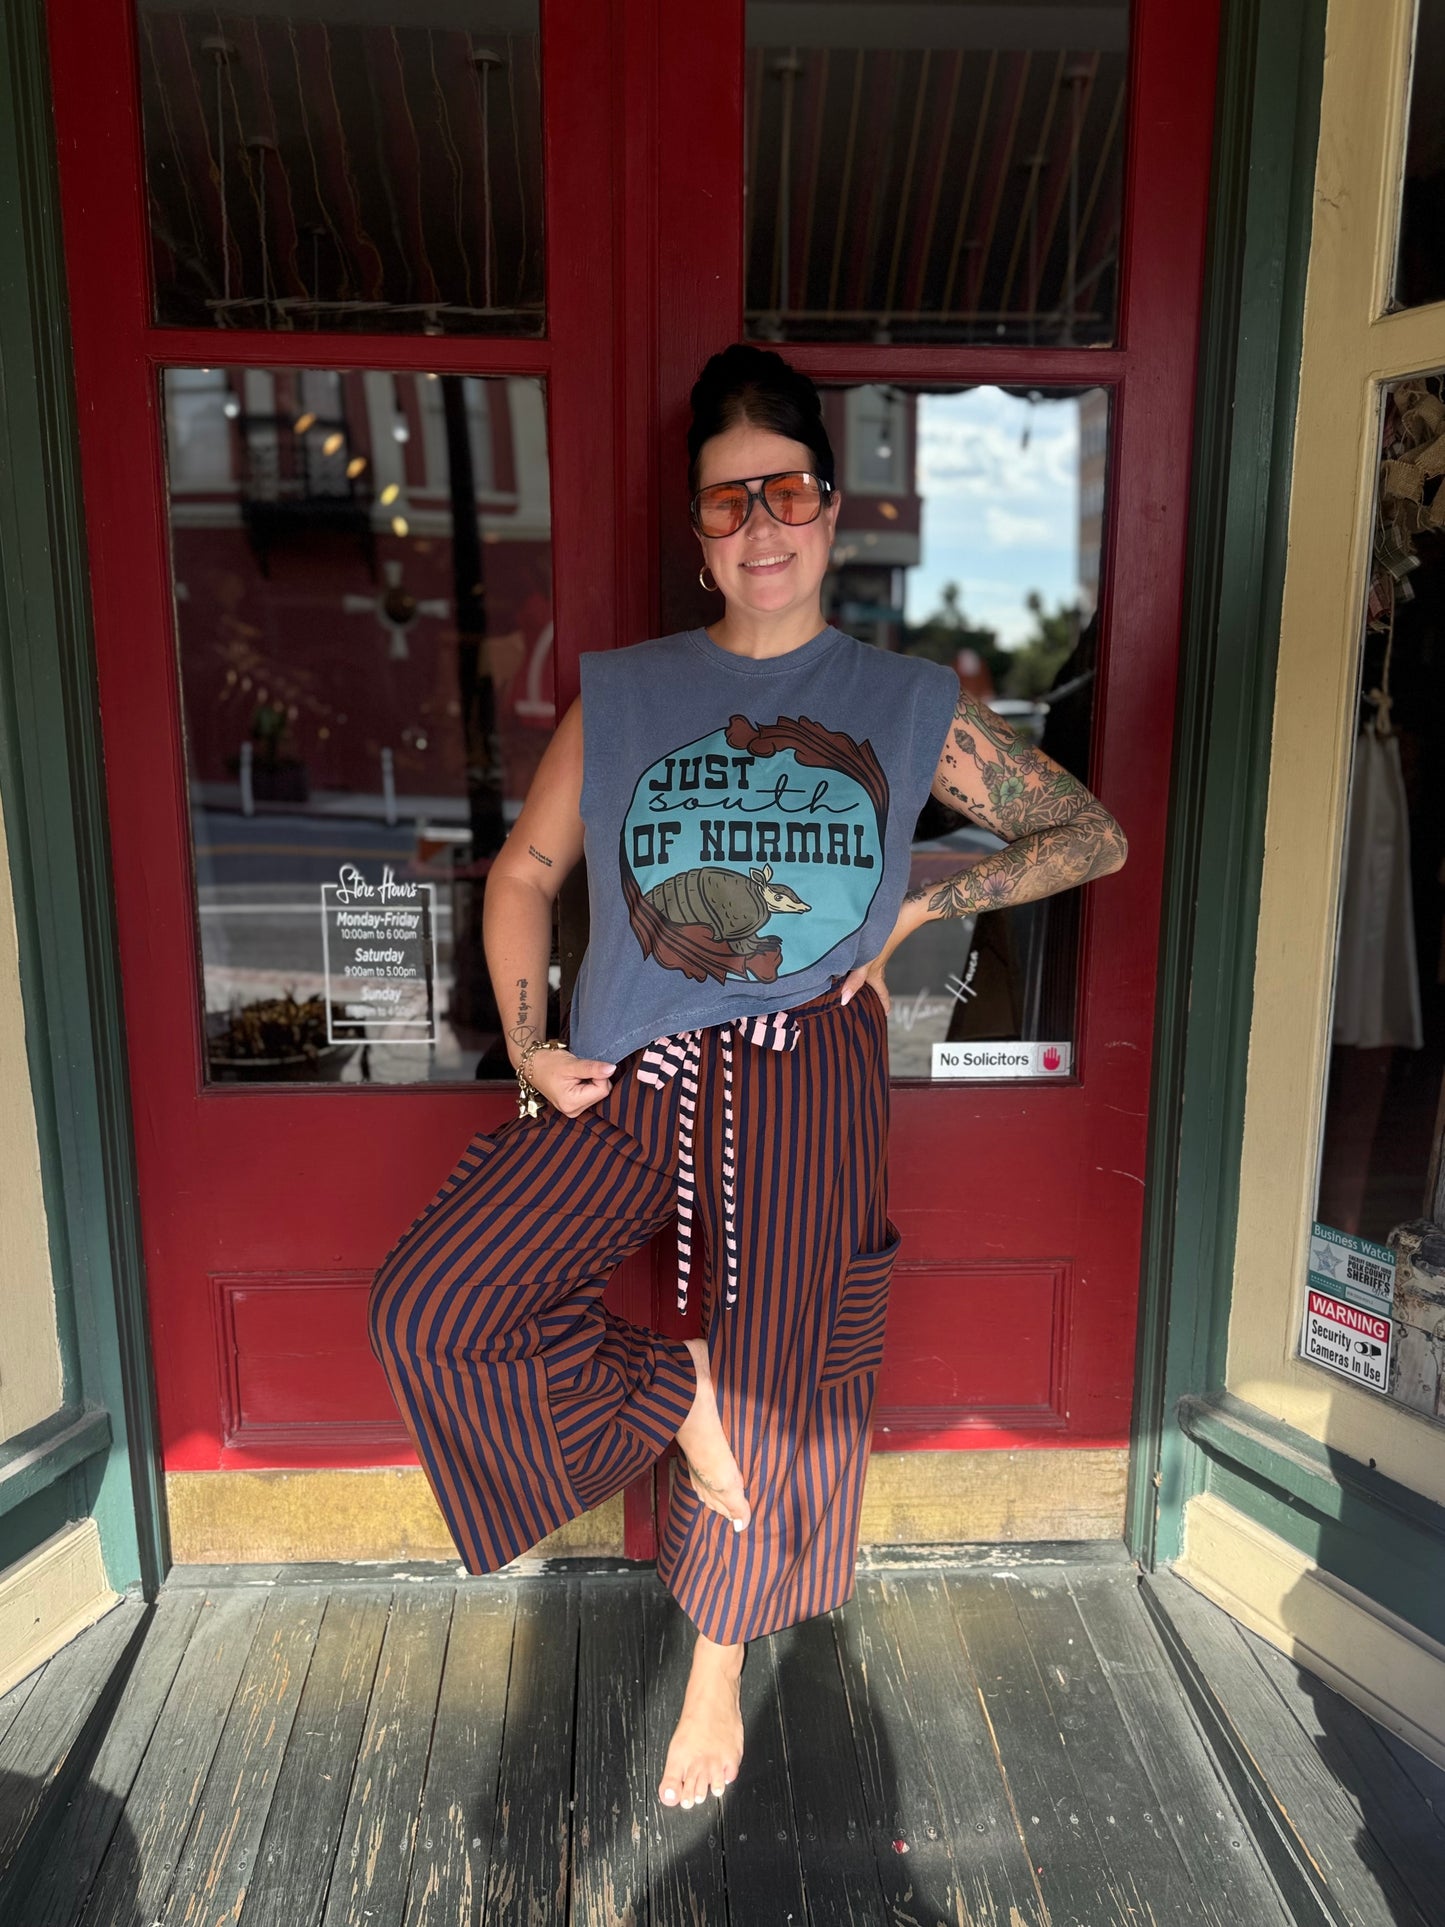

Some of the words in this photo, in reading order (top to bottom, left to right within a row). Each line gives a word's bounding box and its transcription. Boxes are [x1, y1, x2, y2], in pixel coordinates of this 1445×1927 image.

[649, 754, 755, 791] JUST
[649, 774, 859, 814] south
[633, 821, 681, 868] OF
[700, 820, 874, 869] NORMAL
[336, 863, 374, 904] Store
[378, 865, 417, 904] Hours
[336, 911, 420, 929] Monday-Friday
[341, 928, 374, 939] 10:00am
[376, 930, 385, 939] to
[344, 966, 374, 977] 9:00am
[376, 967, 385, 977] to
[355, 947, 404, 964] Saturday
[361, 985, 401, 1003] Sunday
[940, 1053, 959, 1066] No
[963, 1052, 1029, 1066] Solicitors
[1314, 1224, 1358, 1250] Business
[1361, 1241, 1394, 1263] Watch
[1347, 1260, 1364, 1272] POLK
[1364, 1266, 1391, 1282] COUNTY
[1312, 1295, 1385, 1339] WARNING
[1312, 1319, 1351, 1352] Security
[1311, 1338, 1349, 1368] Cameras
[1352, 1356, 1361, 1374] In
[1364, 1361, 1380, 1382] Use
